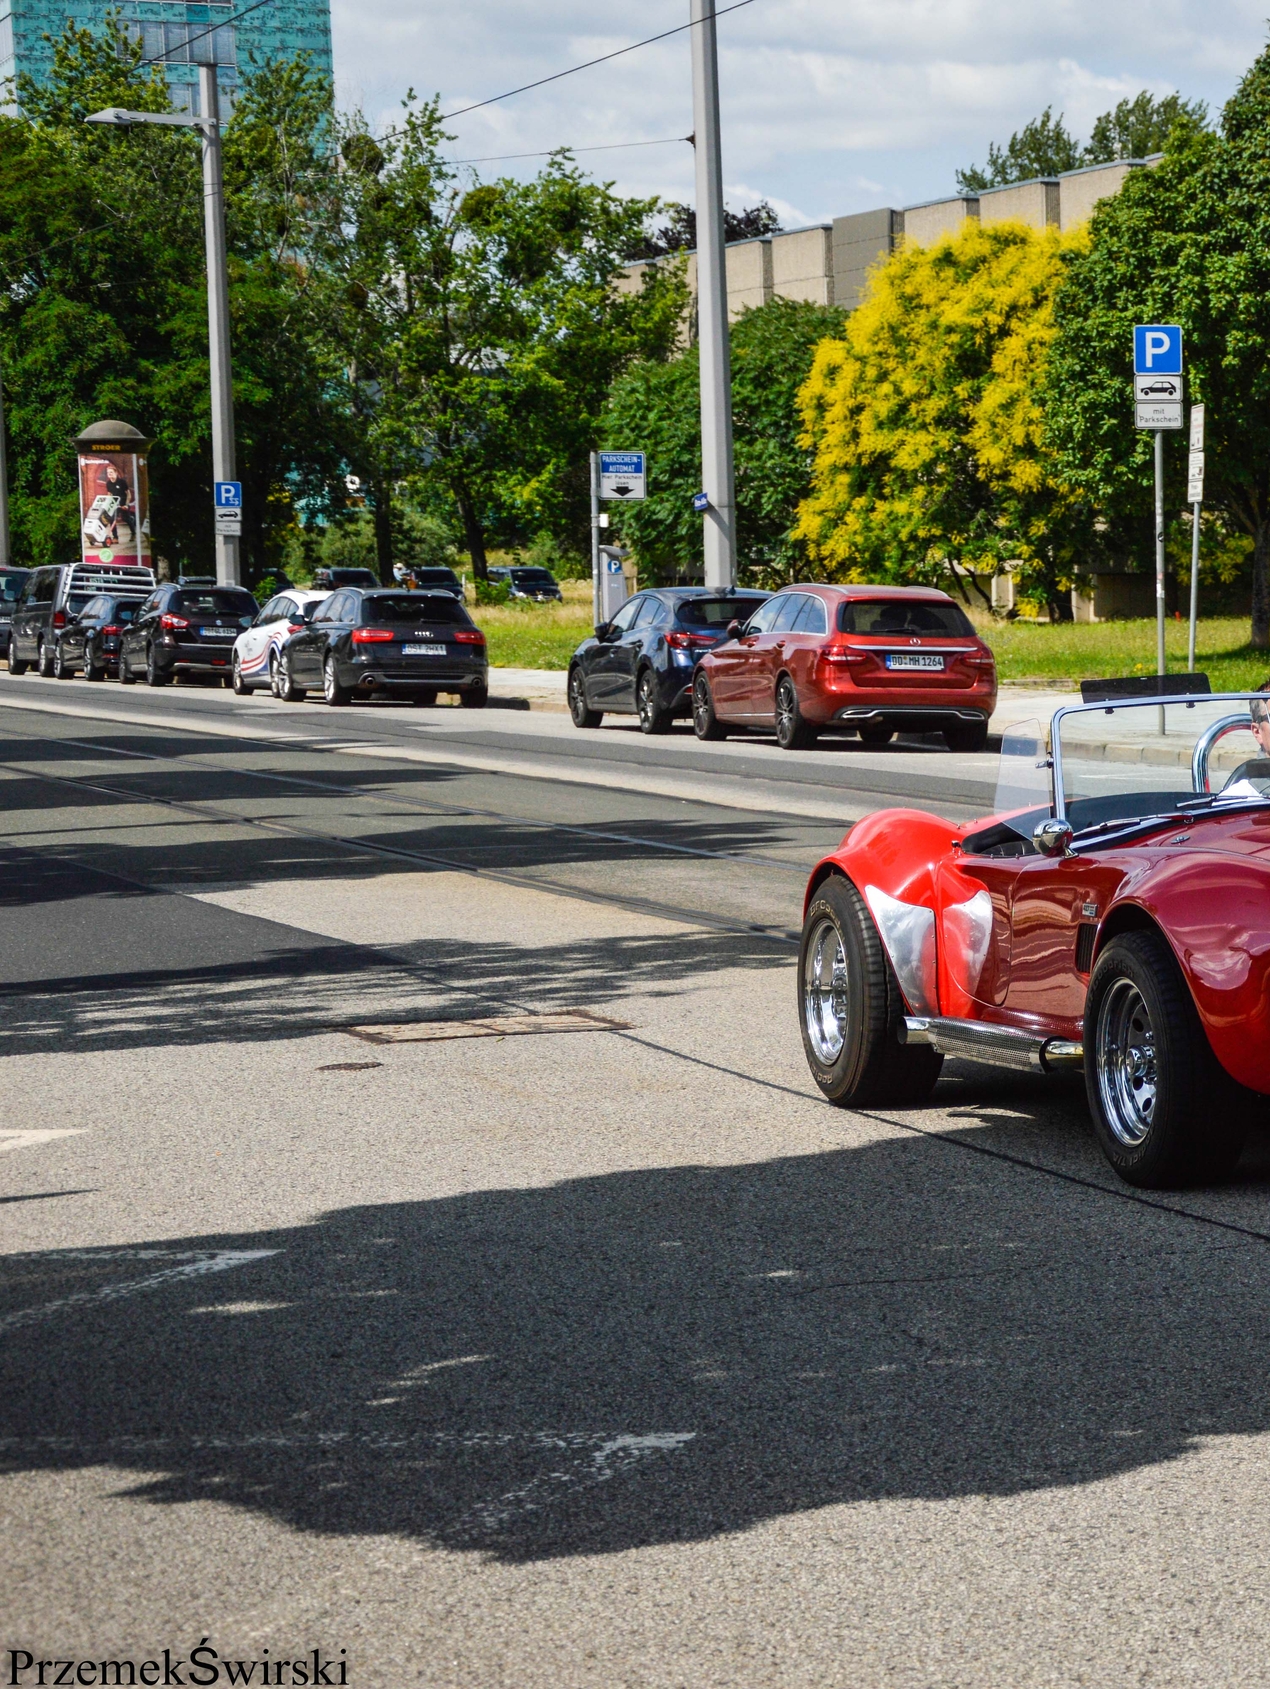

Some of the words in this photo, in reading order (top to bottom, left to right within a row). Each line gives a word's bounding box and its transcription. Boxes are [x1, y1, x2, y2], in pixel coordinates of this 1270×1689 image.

[1145, 331, 1171, 368] P
[1139, 415, 1179, 423] Parkschein
[602, 455, 641, 463] PARKSCHEIN-
[608, 464, 635, 472] AUTOMAT
[221, 485, 236, 504] P
[610, 561, 620, 573] P
[891, 656, 903, 666] DD
[908, 656, 920, 666] MH
[922, 656, 942, 667] 1264
